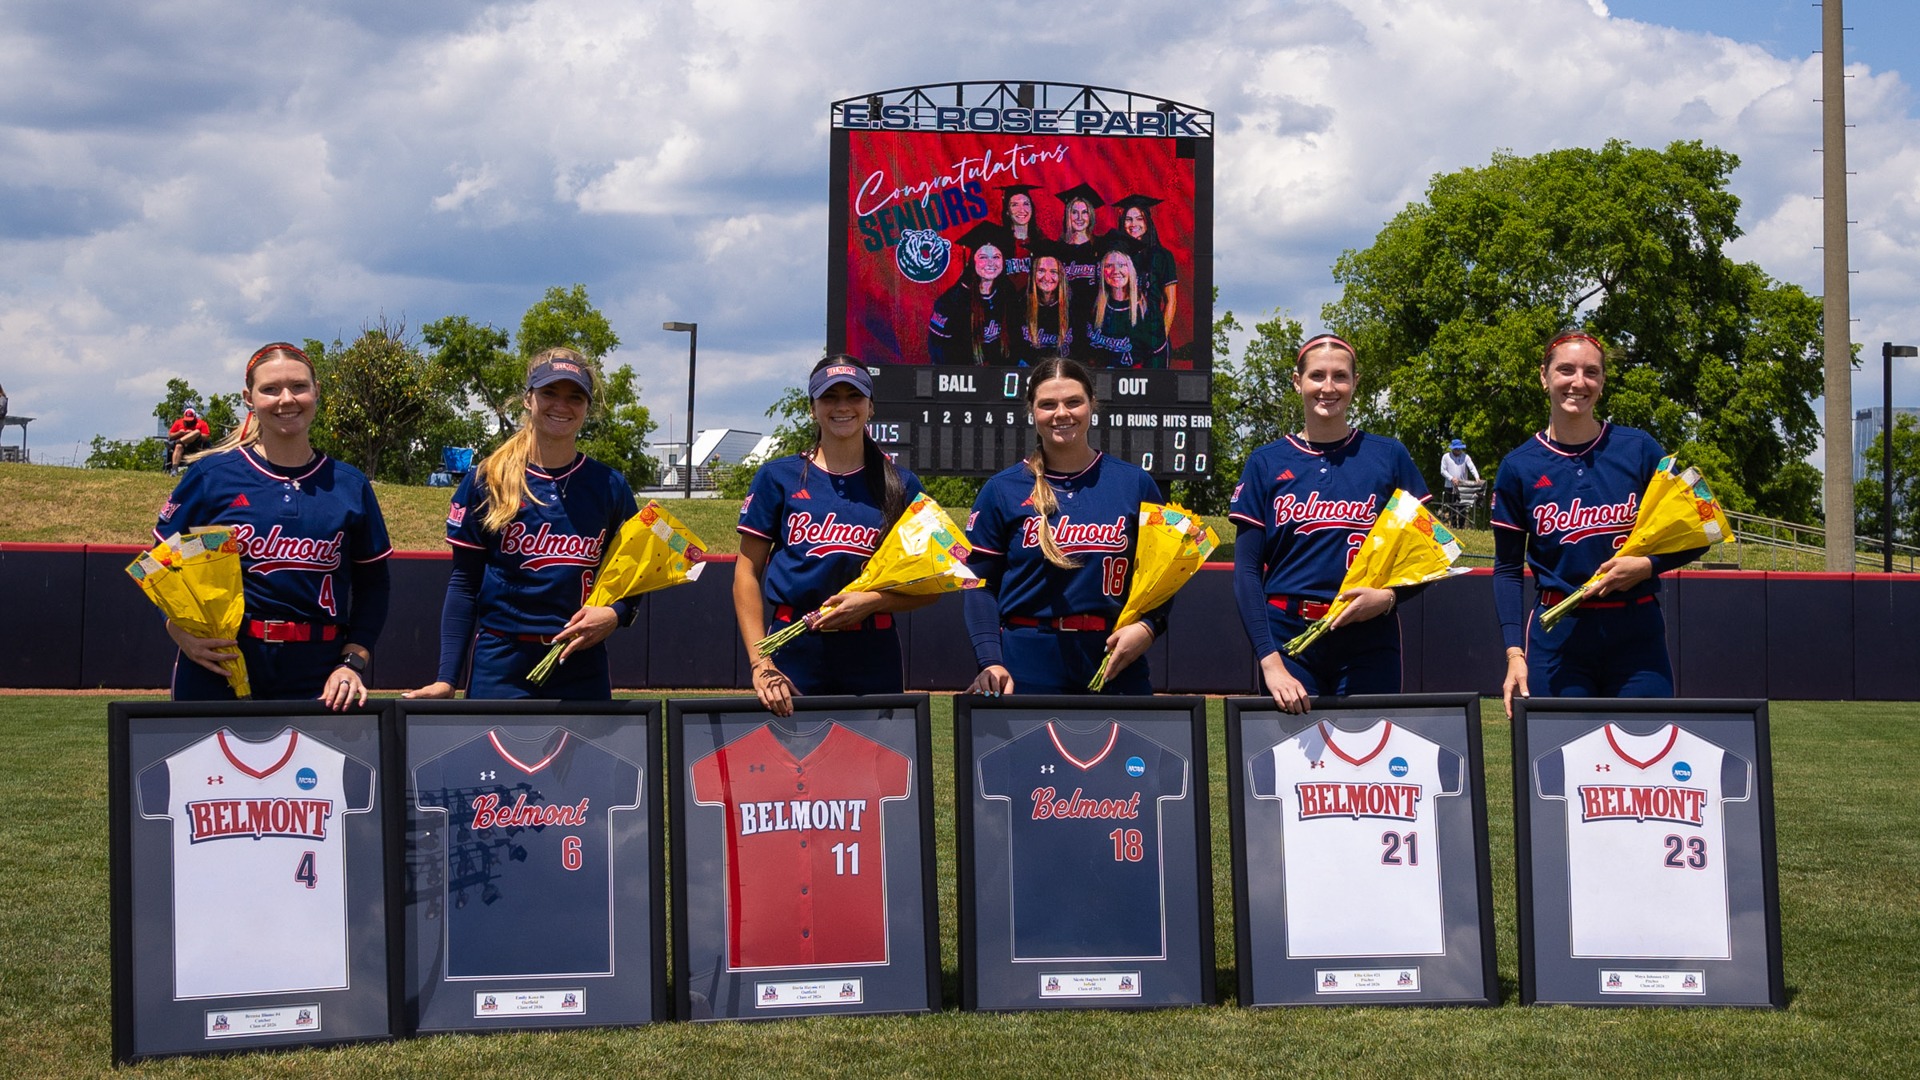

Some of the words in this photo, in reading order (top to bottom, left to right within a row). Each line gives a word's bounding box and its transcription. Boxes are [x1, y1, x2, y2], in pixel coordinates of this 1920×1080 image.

[843, 104, 920, 130] E.S.
[936, 106, 1061, 134] ROSE
[1075, 110, 1202, 137] PARK
[855, 143, 1070, 217] Congratulations
[858, 181, 989, 253] SENIORS
[938, 374, 977, 393] BALL
[1003, 372, 1019, 397] 0
[1118, 377, 1149, 396] OUT
[868, 424, 900, 442] UIS
[922, 410, 929, 423] 1
[943, 410, 951, 424] 2
[964, 411, 972, 424] 3
[985, 411, 993, 425] 4
[1006, 412, 1014, 425] 5
[1091, 413, 1099, 427] 9
[1109, 413, 1123, 427] 10
[1127, 414, 1158, 427] RUNS
[1162, 414, 1187, 428] HITS
[1190, 415, 1212, 428] ERR
[1174, 431, 1186, 450] 0
[1142, 452, 1153, 471] 0
[1174, 453, 1186, 472] 0
[1195, 453, 1206, 472] 0
[1274, 491, 1378, 527] Belmont
[1532, 492, 1640, 536] Belmont
[231, 524, 344, 563] Belmont
[501, 522, 607, 558] Belmont
[787, 511, 880, 548] Belmon
[1022, 515, 1127, 548] Blmont
[1102, 556, 1129, 596] 18
[318, 574, 337, 616] 4
[298, 776, 316, 785] NCAA
[1128, 765, 1145, 773] NCAA
[471, 793, 590, 829] Belmont
[739, 799, 867, 836] BELMONT
[1031, 786, 1141, 820] Belmont
[1295, 781, 1422, 822] BELMONT
[1577, 784, 1708, 828] BELMONT
[186, 797, 334, 845] BELMONT
[562, 835, 583, 871] 6
[831, 842, 860, 875] 11
[1109, 828, 1144, 862] 18
[1381, 830, 1418, 866] 21
[1664, 833, 1708, 870] 23
[295, 851, 317, 889] 4
